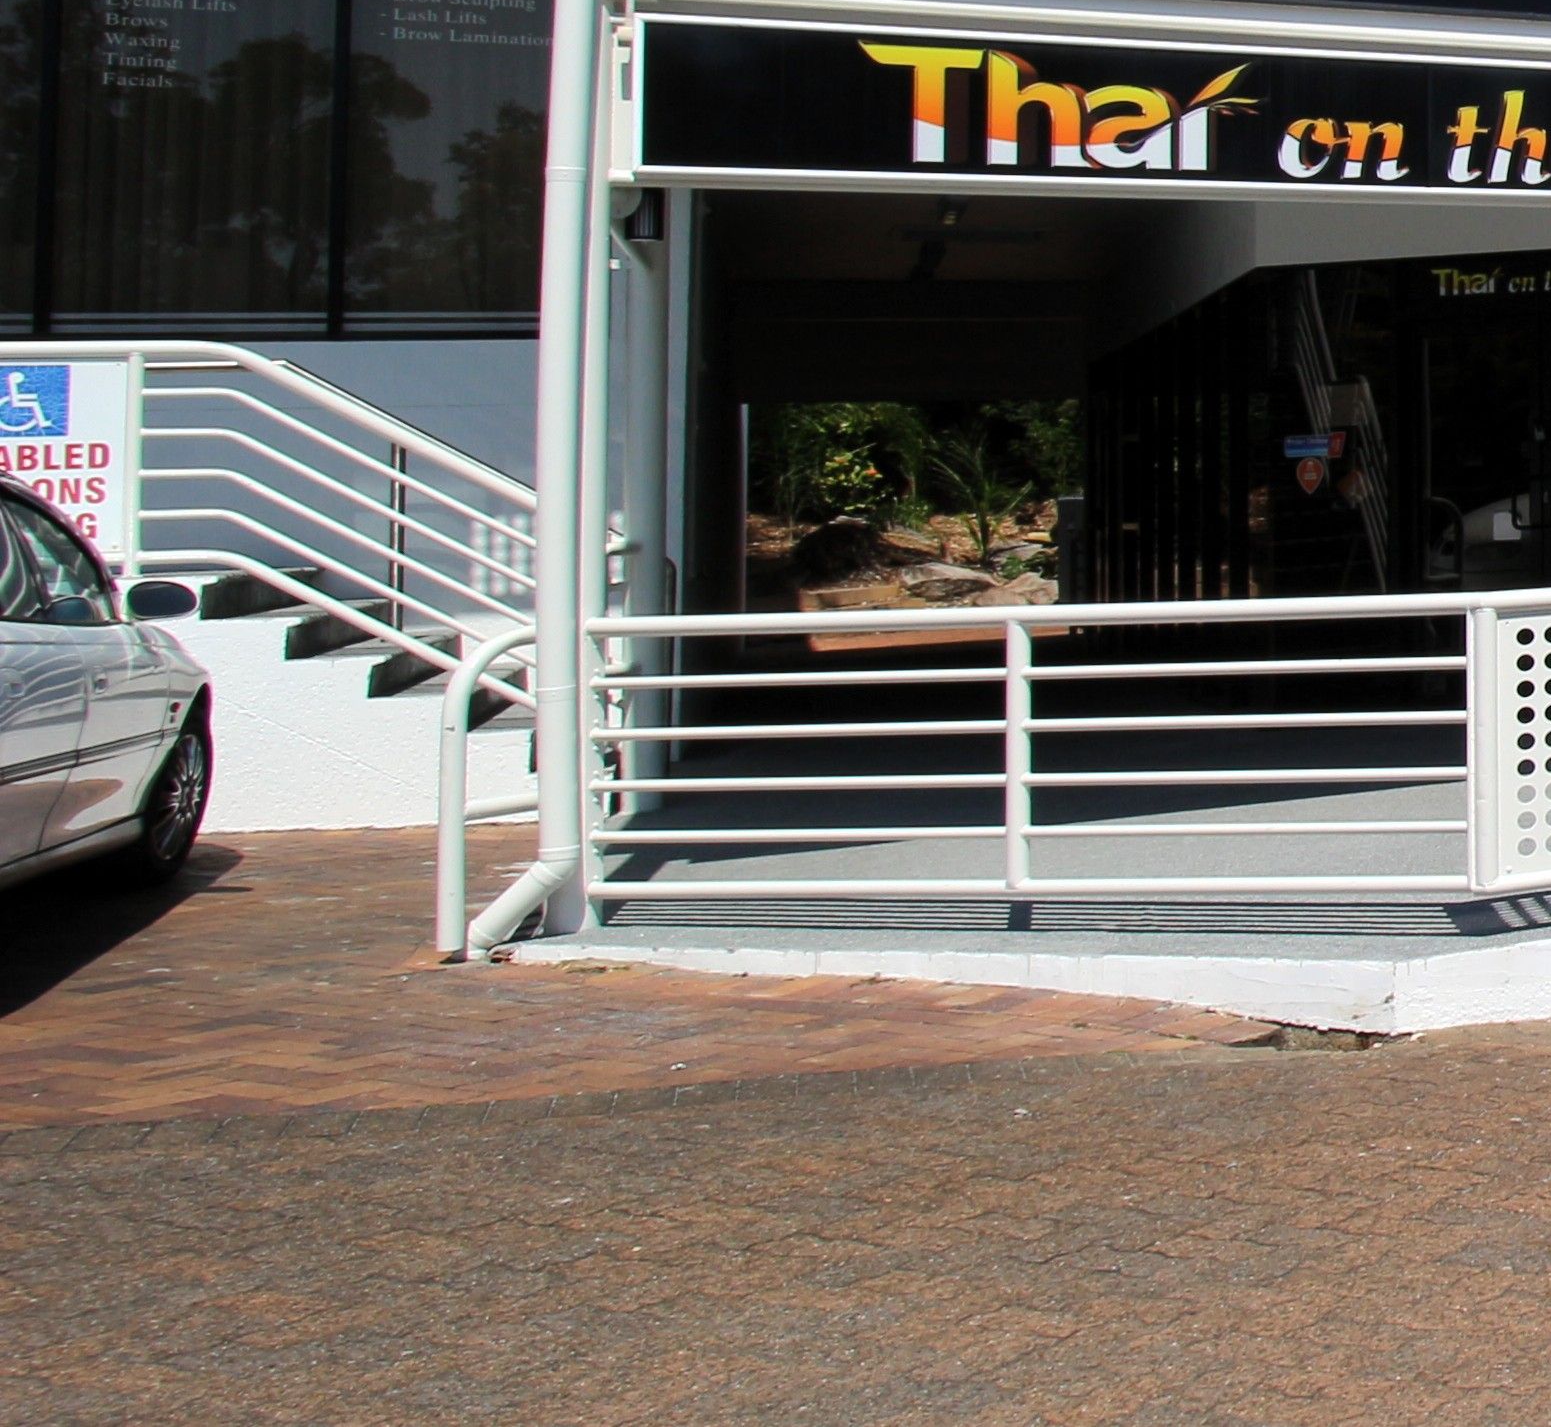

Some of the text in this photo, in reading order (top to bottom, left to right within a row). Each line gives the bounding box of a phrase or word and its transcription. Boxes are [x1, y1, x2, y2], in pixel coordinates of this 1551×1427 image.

[104, 12, 168, 28] Brows
[393, 8, 488, 25] Lash Lifts
[104, 32, 181, 51] Waxing
[393, 27, 442, 42] Brow
[103, 52, 178, 72] Tinting
[102, 72, 174, 88] Facials
[857, 39, 1267, 171] Thai
[1277, 116, 1411, 183] on
[1431, 267, 1504, 297] Thai
[1508, 274, 1536, 294] on
